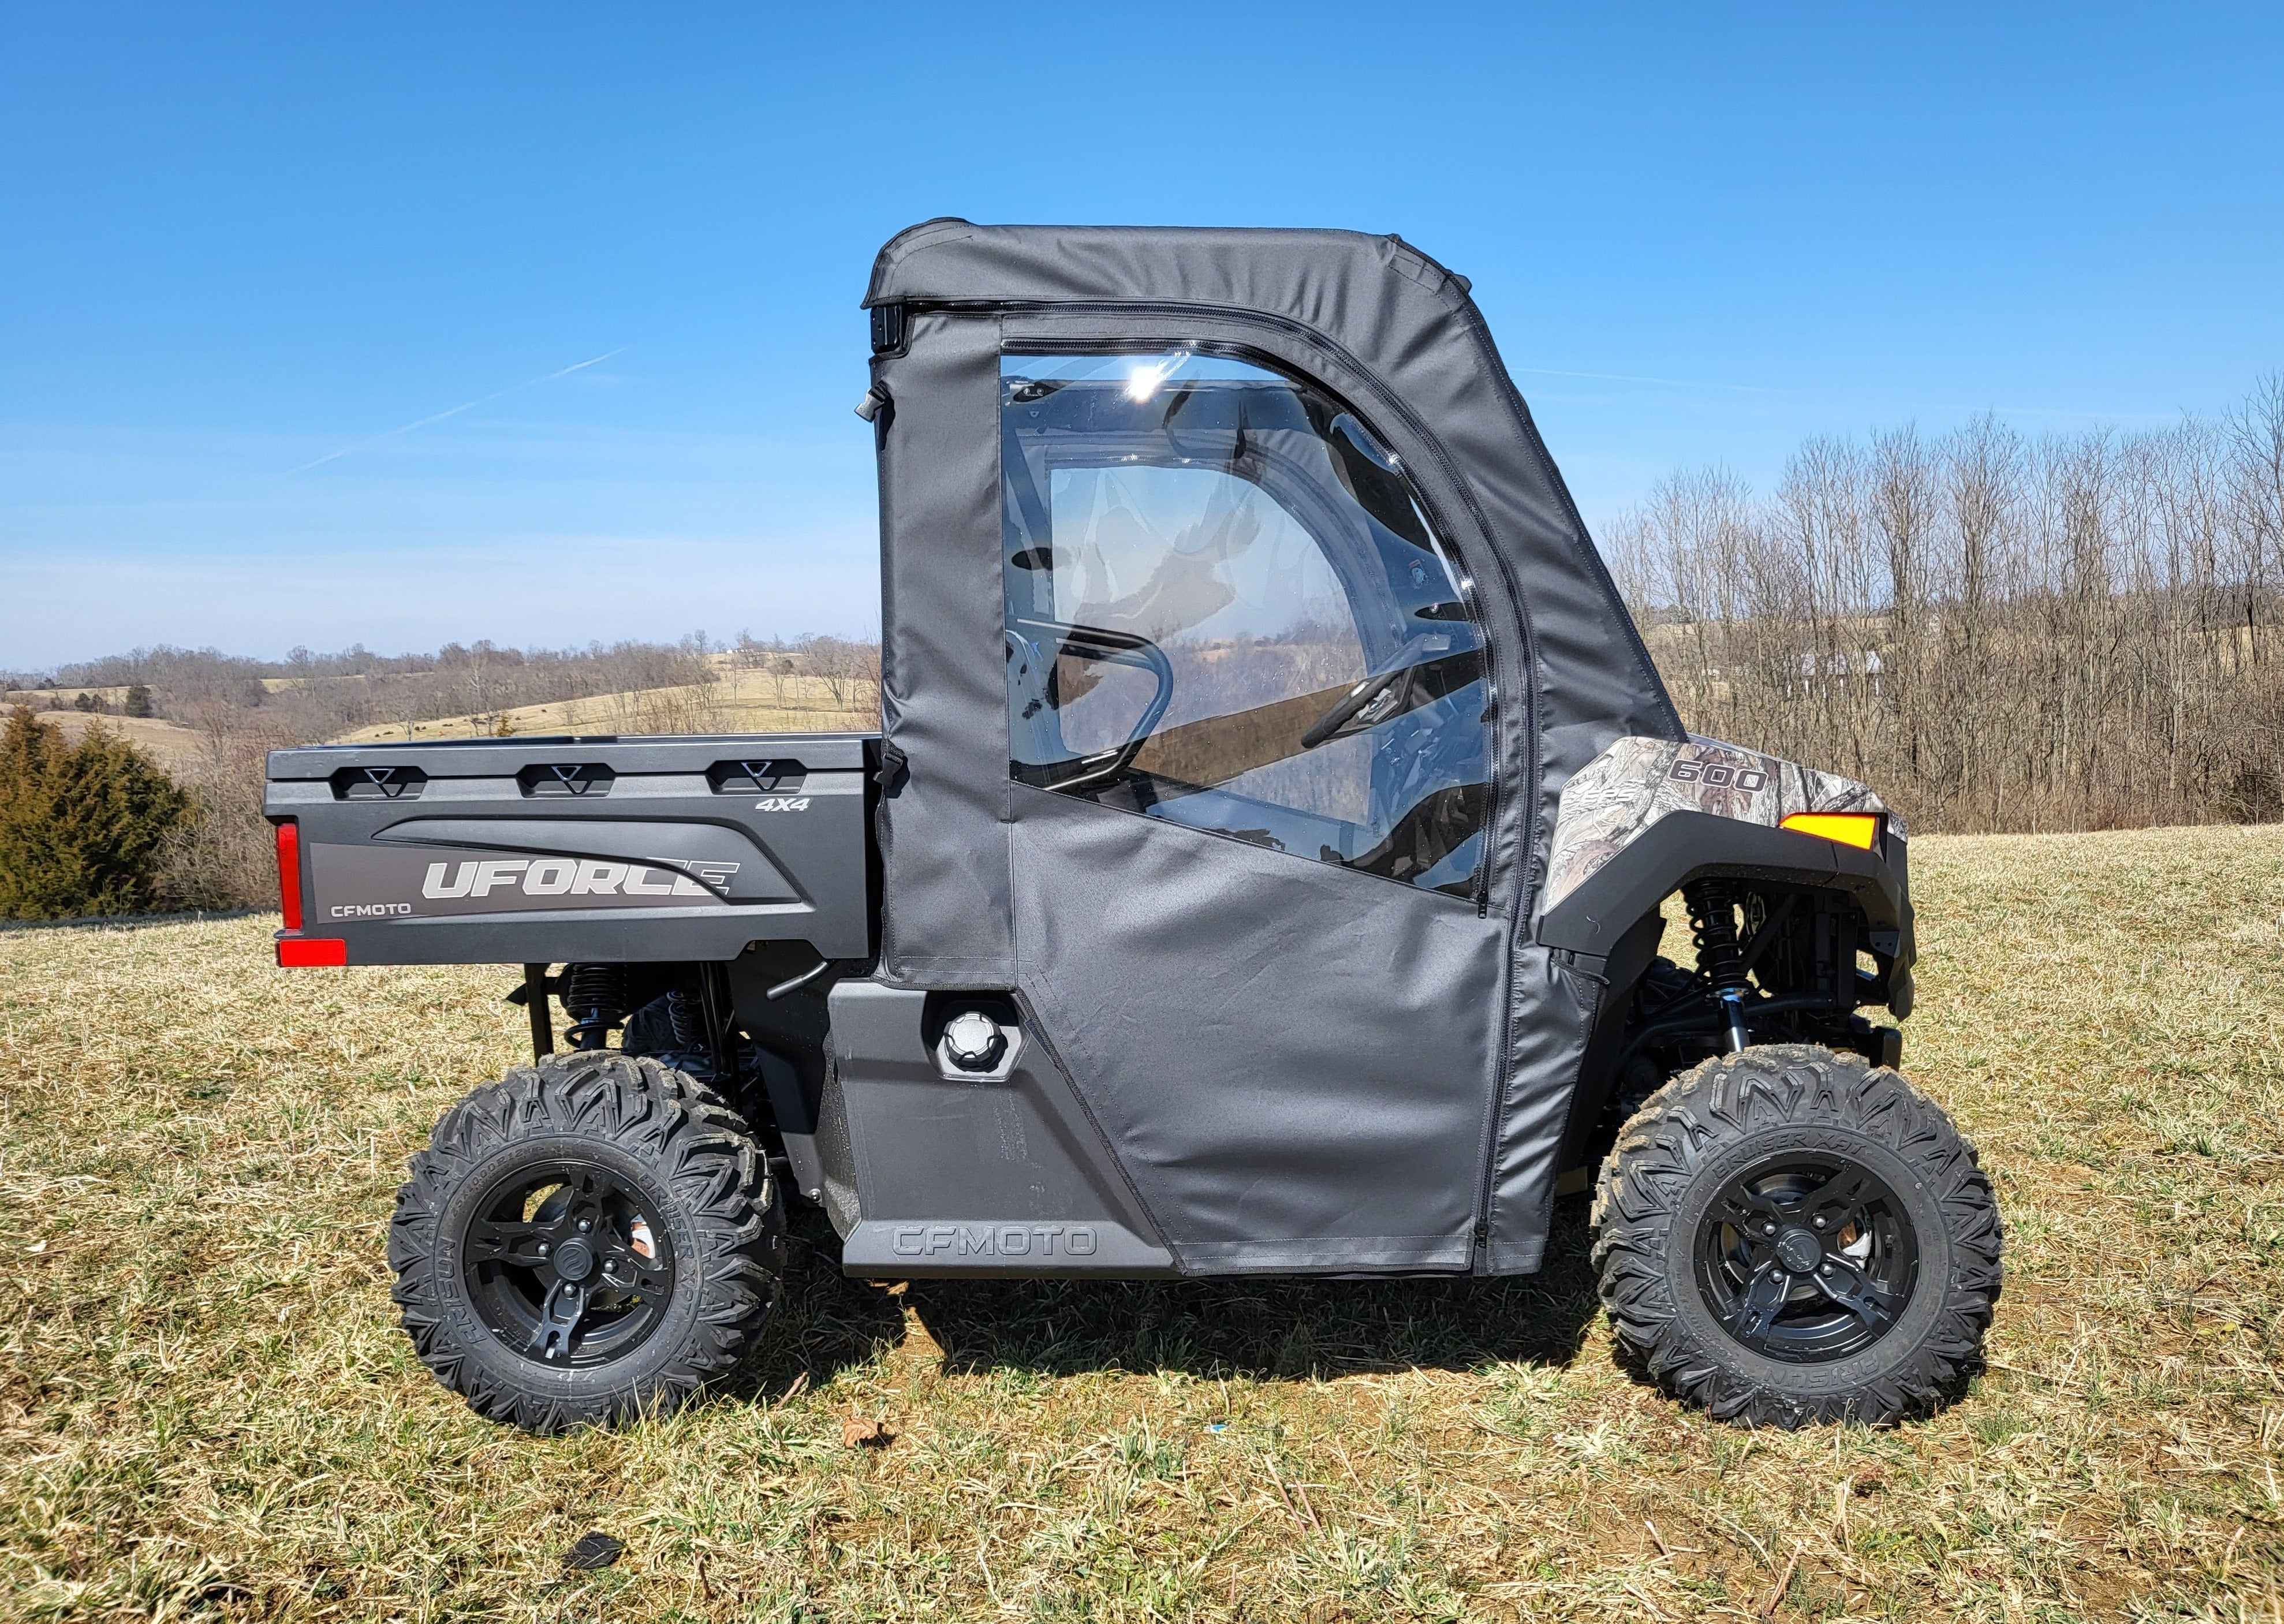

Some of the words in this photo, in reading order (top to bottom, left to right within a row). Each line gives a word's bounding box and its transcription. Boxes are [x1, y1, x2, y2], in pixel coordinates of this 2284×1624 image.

[1667, 759, 1769, 792] 600
[755, 798, 810, 811] 4X4
[422, 857, 741, 898] UFORCE
[331, 903, 411, 917] CFMOTO
[1712, 1132, 1807, 1178] BRUISER
[892, 1226, 1097, 1256] CFMOTO
[438, 1235, 487, 1344] ARISUN
